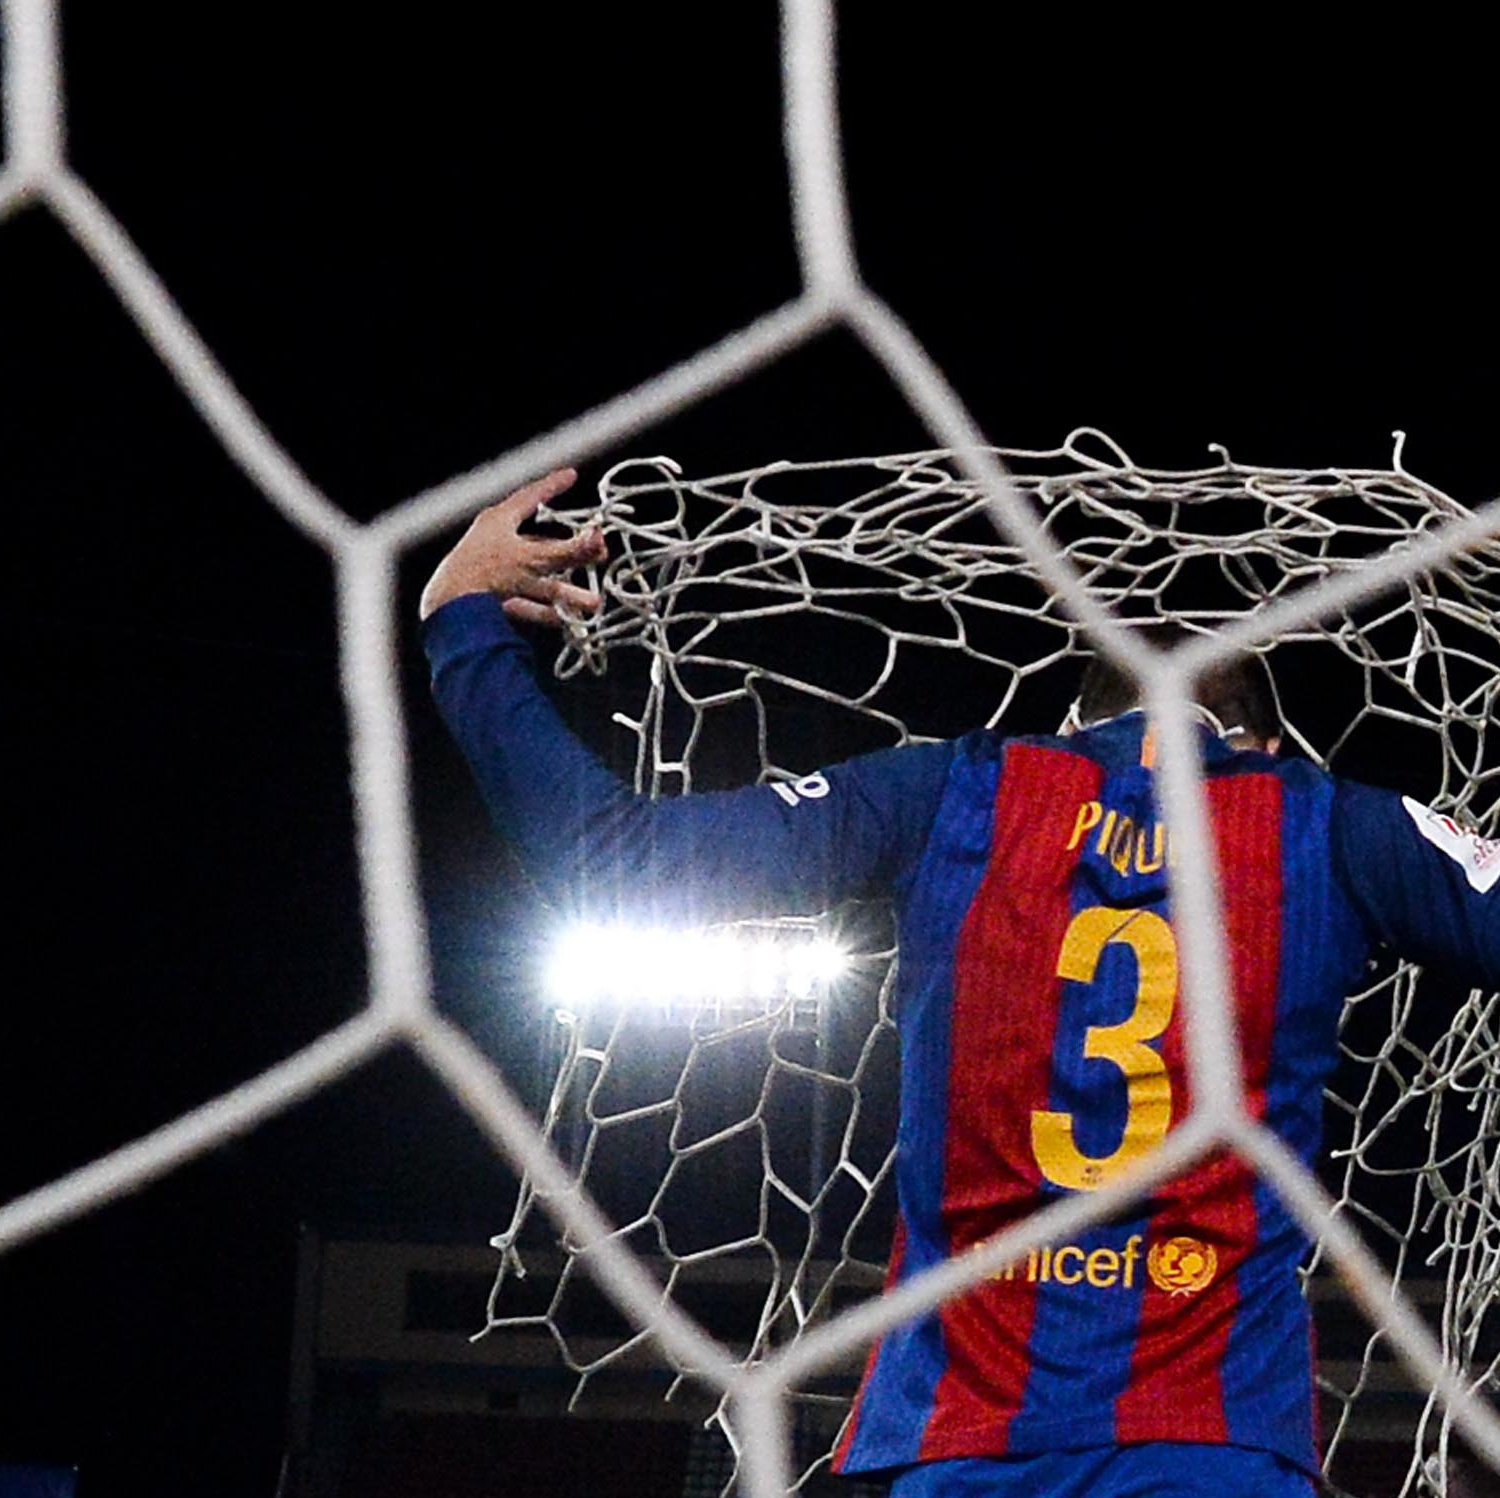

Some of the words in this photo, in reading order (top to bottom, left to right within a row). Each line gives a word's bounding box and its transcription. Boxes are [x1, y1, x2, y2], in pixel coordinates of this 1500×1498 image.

[1066, 801, 1176, 878] PIQU
[1031, 906, 1177, 1192] 3
[974, 1235, 1143, 1288] nicef
